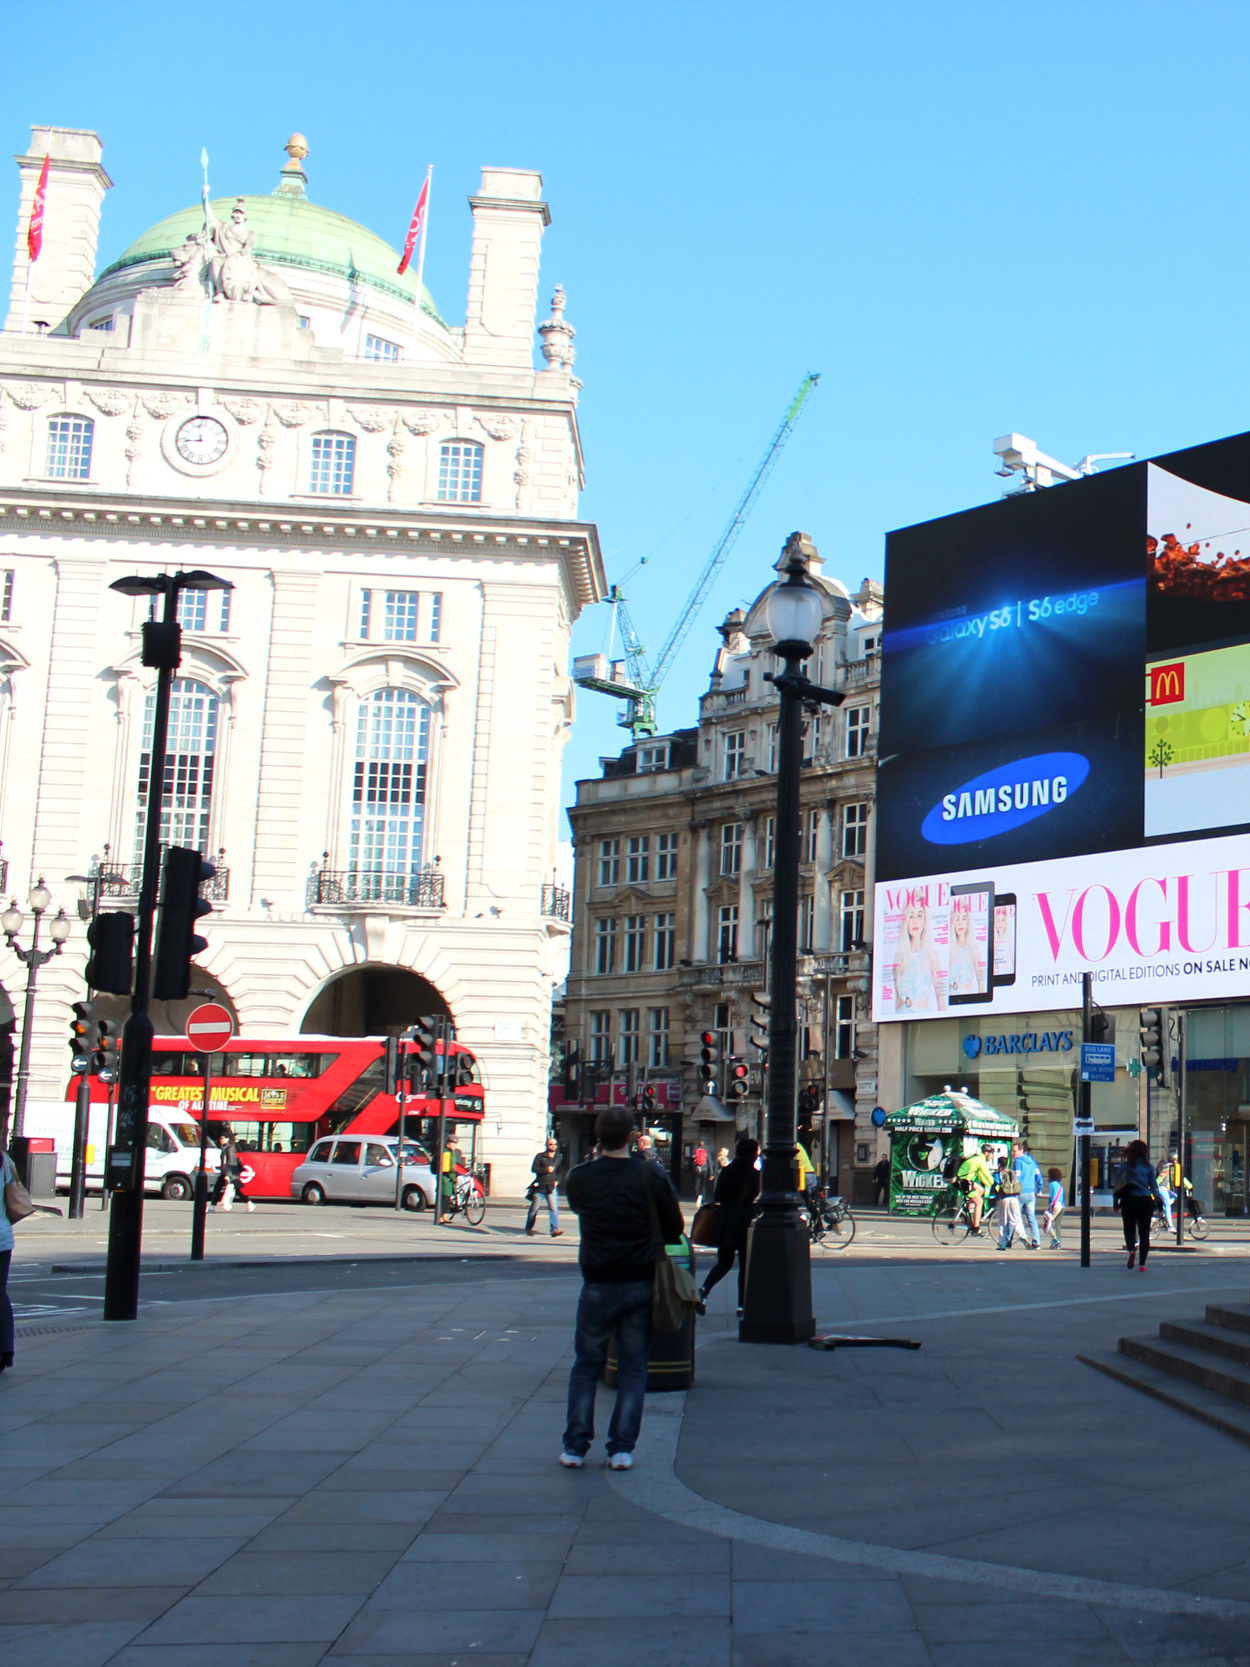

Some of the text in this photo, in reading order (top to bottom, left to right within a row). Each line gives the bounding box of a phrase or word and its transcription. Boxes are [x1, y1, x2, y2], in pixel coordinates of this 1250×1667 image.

[989, 607, 1012, 630] S6
[1028, 596, 1052, 621] S6
[1055, 592, 1099, 615] edge
[942, 776, 1067, 821] SAMSUNG
[885, 882, 950, 912] VOGUE
[1032, 974, 1060, 987] PRINT
[1062, 972, 1084, 985] AND
[1129, 963, 1181, 979] EDITIONS
[1183, 962, 1202, 975] ON
[1206, 959, 1235, 973] SALE
[984, 1031, 1073, 1055] BARCLAYS
[178, 1101, 188, 1110] OF
[209, 1101, 228, 1111] TIME
[210, 1087, 259, 1102] MUSICAL
